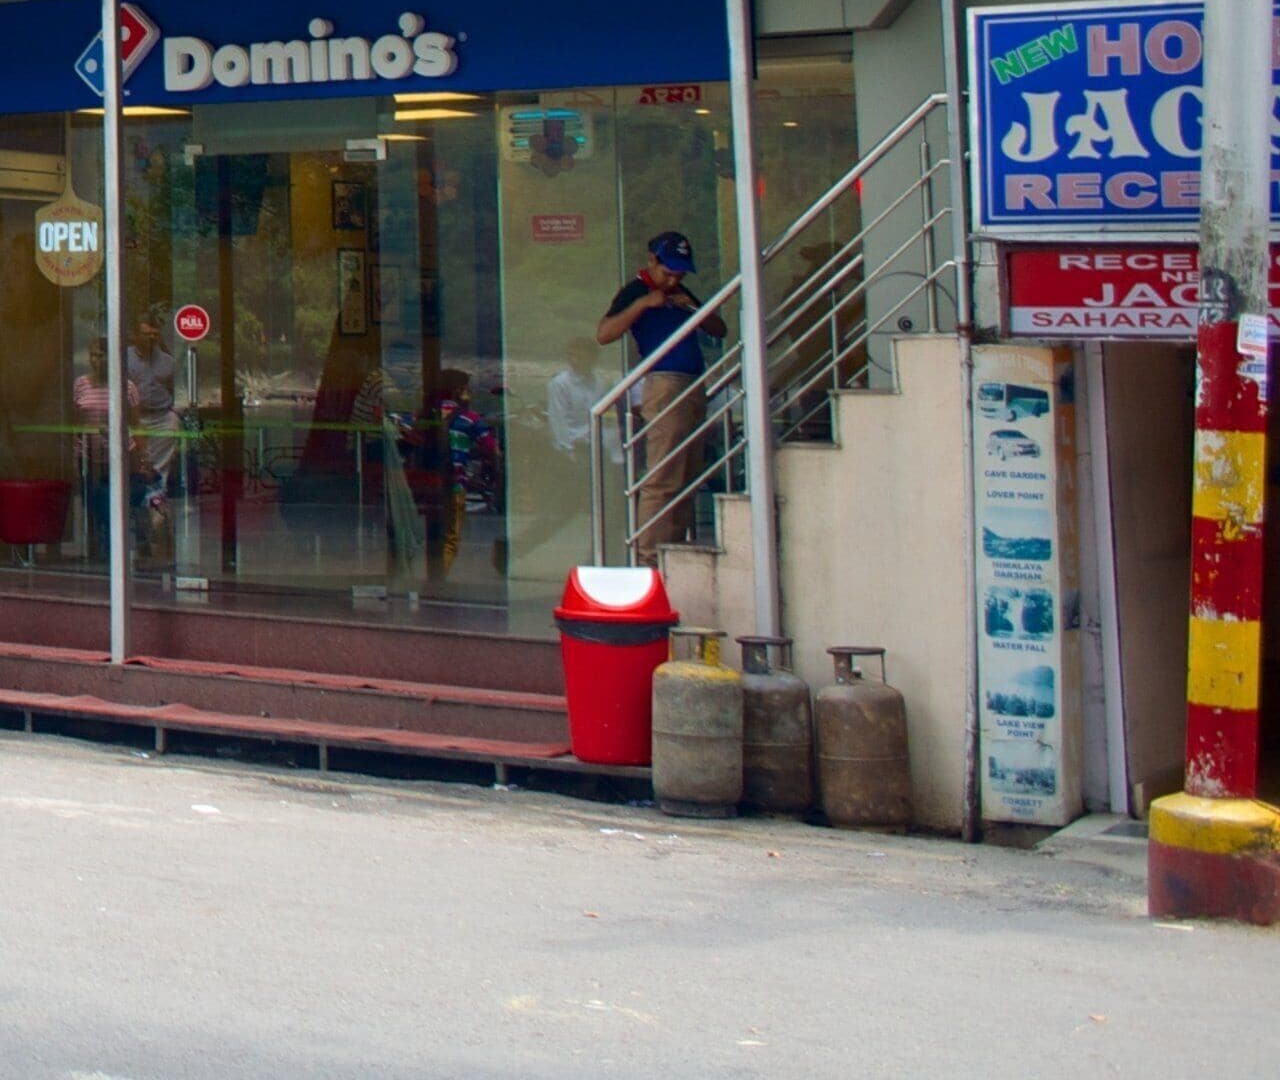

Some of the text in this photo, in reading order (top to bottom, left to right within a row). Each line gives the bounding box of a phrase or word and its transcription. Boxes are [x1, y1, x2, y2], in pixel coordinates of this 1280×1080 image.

[163, 12, 458, 92] Domino's
[991, 23, 1079, 85] NEW
[39, 221, 99, 253] OPEN
[180, 317, 204, 329] PULL
[984, 470, 1047, 480] CAVE GARDEN
[986, 490, 1044, 500] LOVER POINT
[992, 562, 1043, 571] HIMALAYA
[993, 570, 1042, 580] DARSHAN
[993, 642, 1047, 653] WATER FALL
[996, 719, 1046, 730] LAKE VIEW
[1007, 729, 1034, 738] POINT
